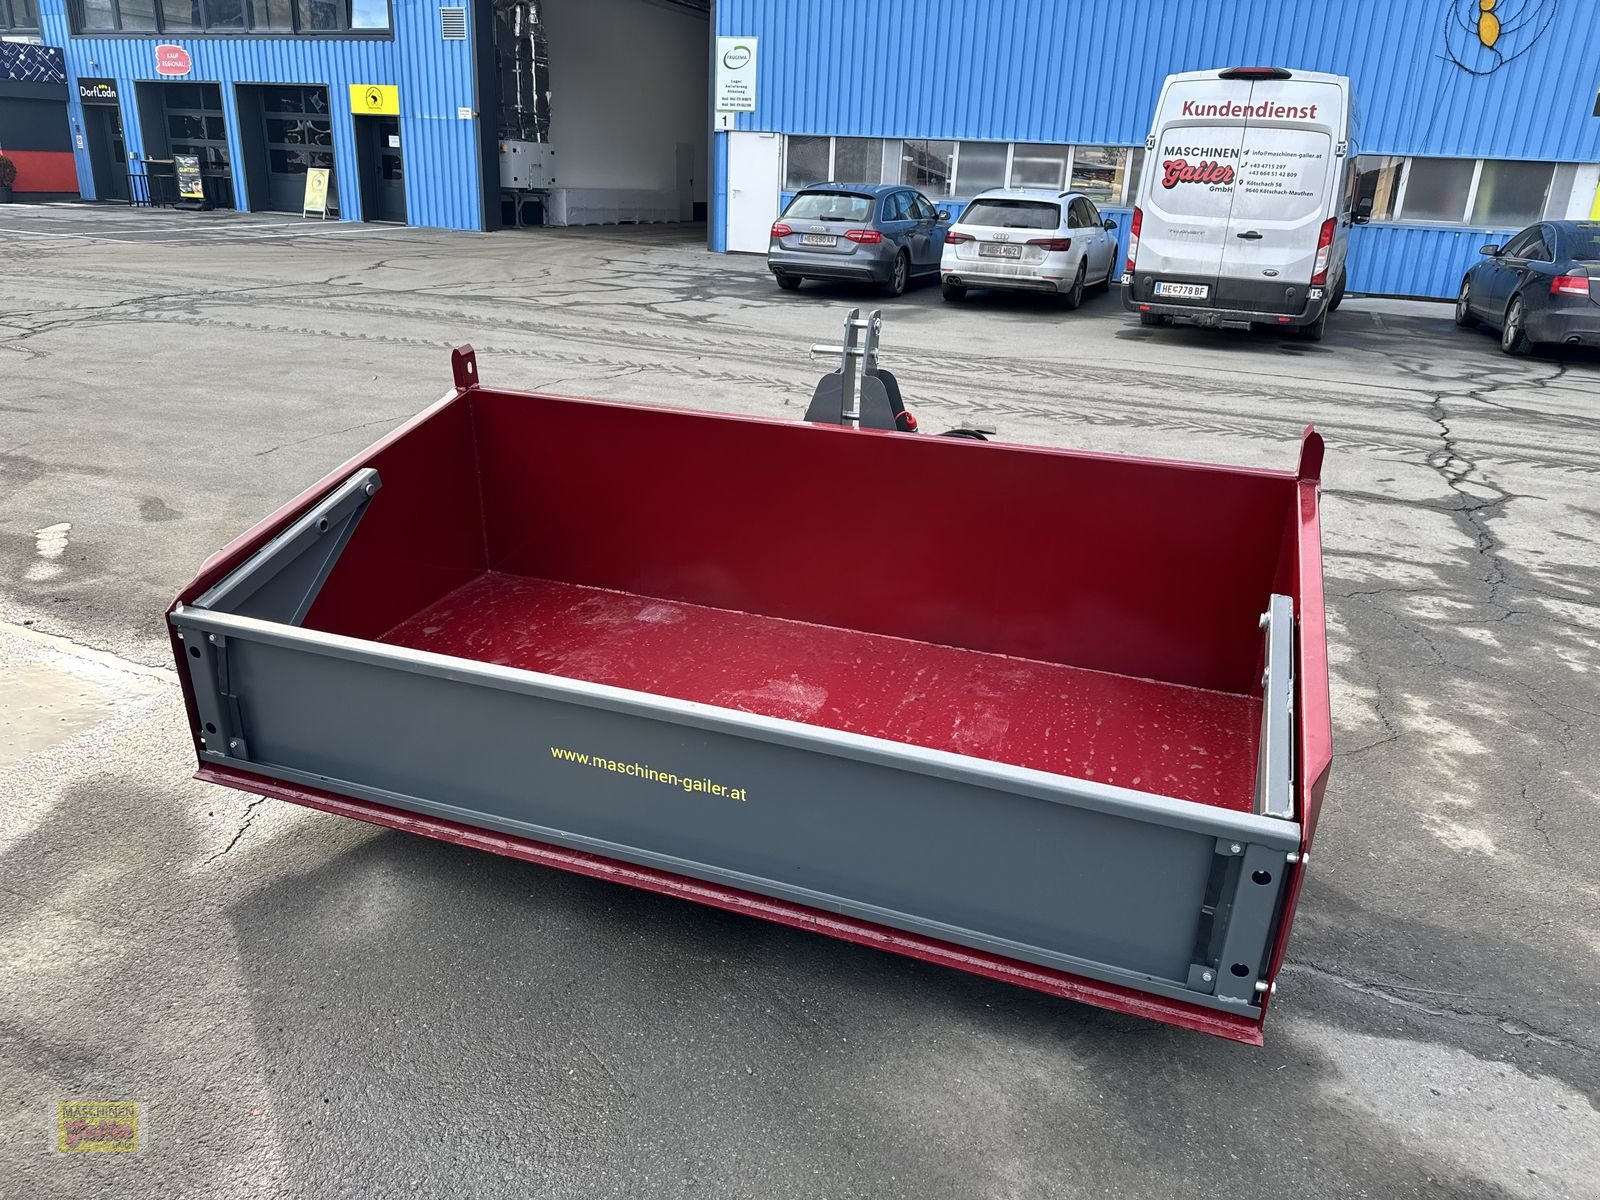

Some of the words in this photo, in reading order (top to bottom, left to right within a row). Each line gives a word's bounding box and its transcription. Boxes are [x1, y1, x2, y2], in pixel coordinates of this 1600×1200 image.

[79, 85, 117, 98] DorfLodn
[1182, 100, 1318, 119] Kundendienst
[721, 115, 727, 127] 1
[1164, 146, 1240, 159] MASCHINEN
[1252, 150, 1322, 159] info@maschinen-gailer.at
[1162, 159, 1235, 190] Gailer
[1162, 285, 1173, 294] HE
[1178, 286, 1194, 295] 778
[1194, 287, 1205, 296] BF
[550, 746, 748, 802] www.maschinen-gailer.at
